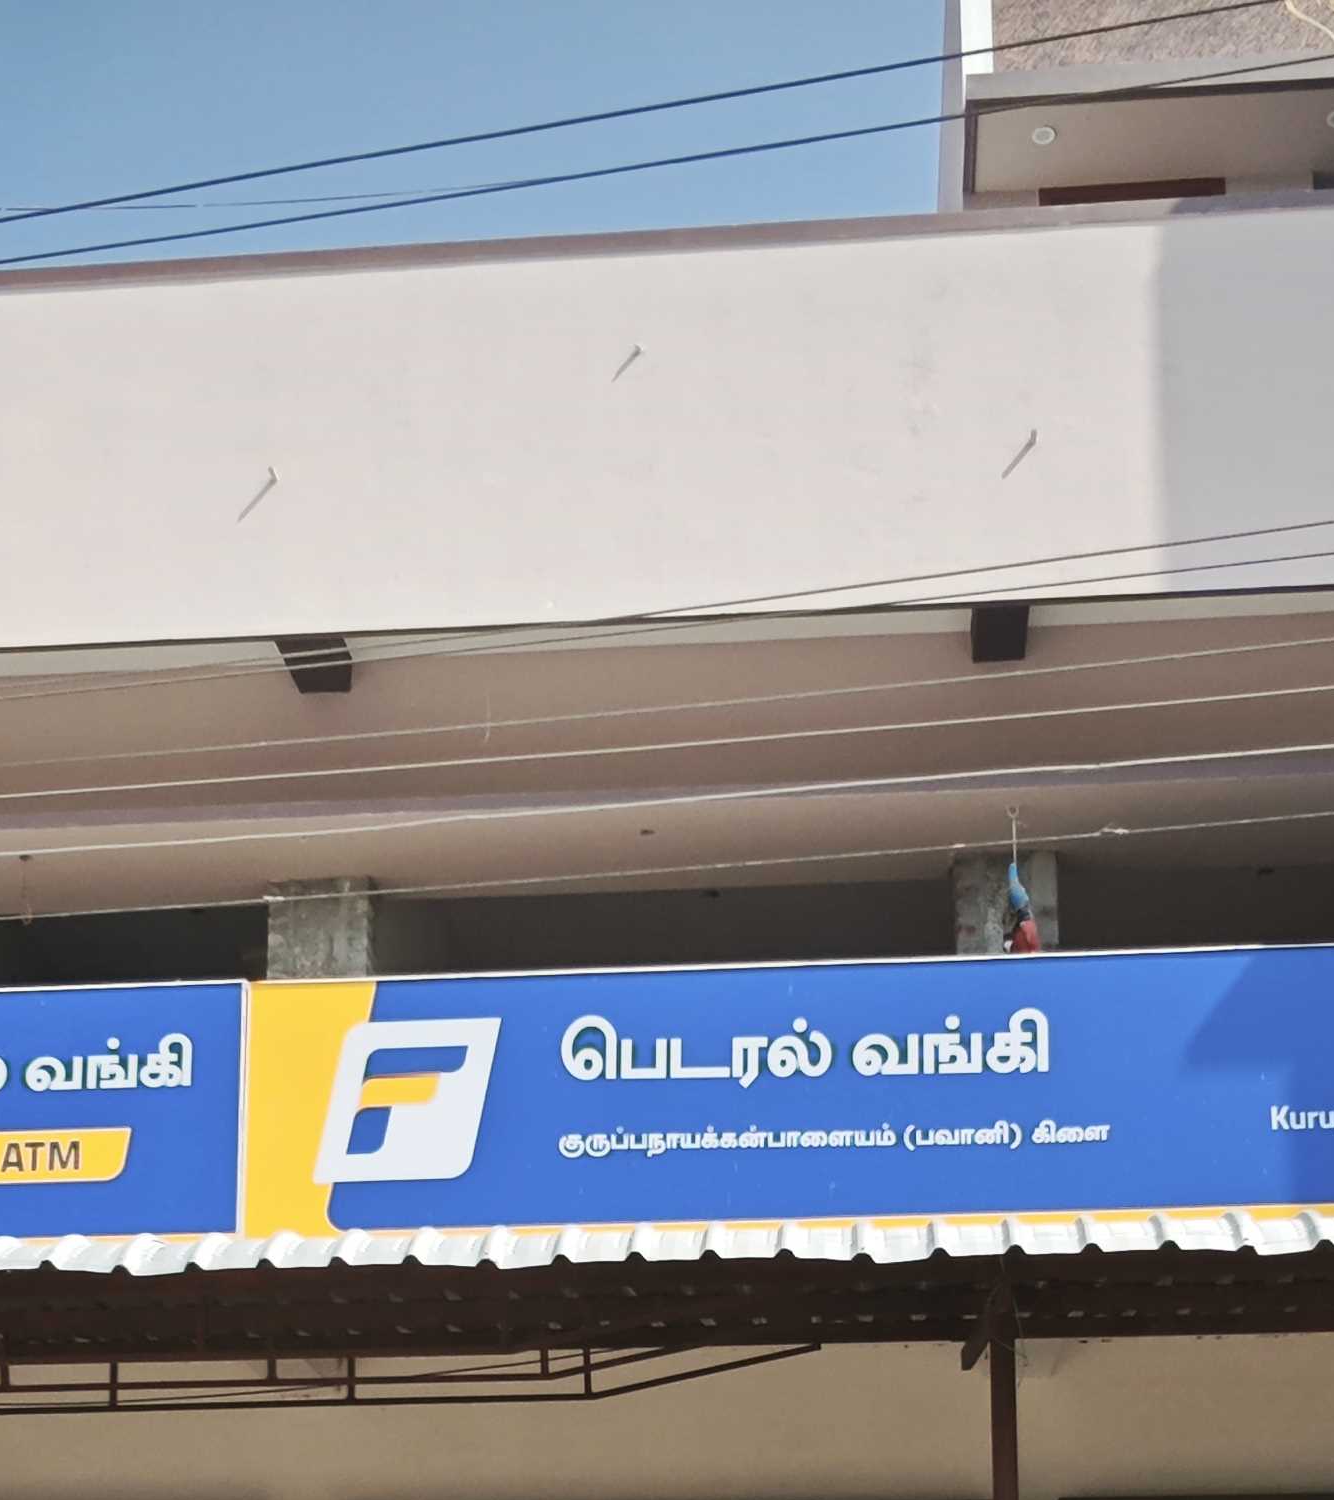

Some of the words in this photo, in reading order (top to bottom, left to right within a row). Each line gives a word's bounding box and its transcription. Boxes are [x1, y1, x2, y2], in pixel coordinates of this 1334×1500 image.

[24, 1034, 194, 1092] வங்கி
[561, 1014, 833, 1089] பெடரல்
[851, 1007, 1051, 1079] வங்கி
[1, 1139, 82, 1173] ATM
[903, 1121, 1023, 1153] (பவானி)
[1031, 1119, 1111, 1145] கிளை
